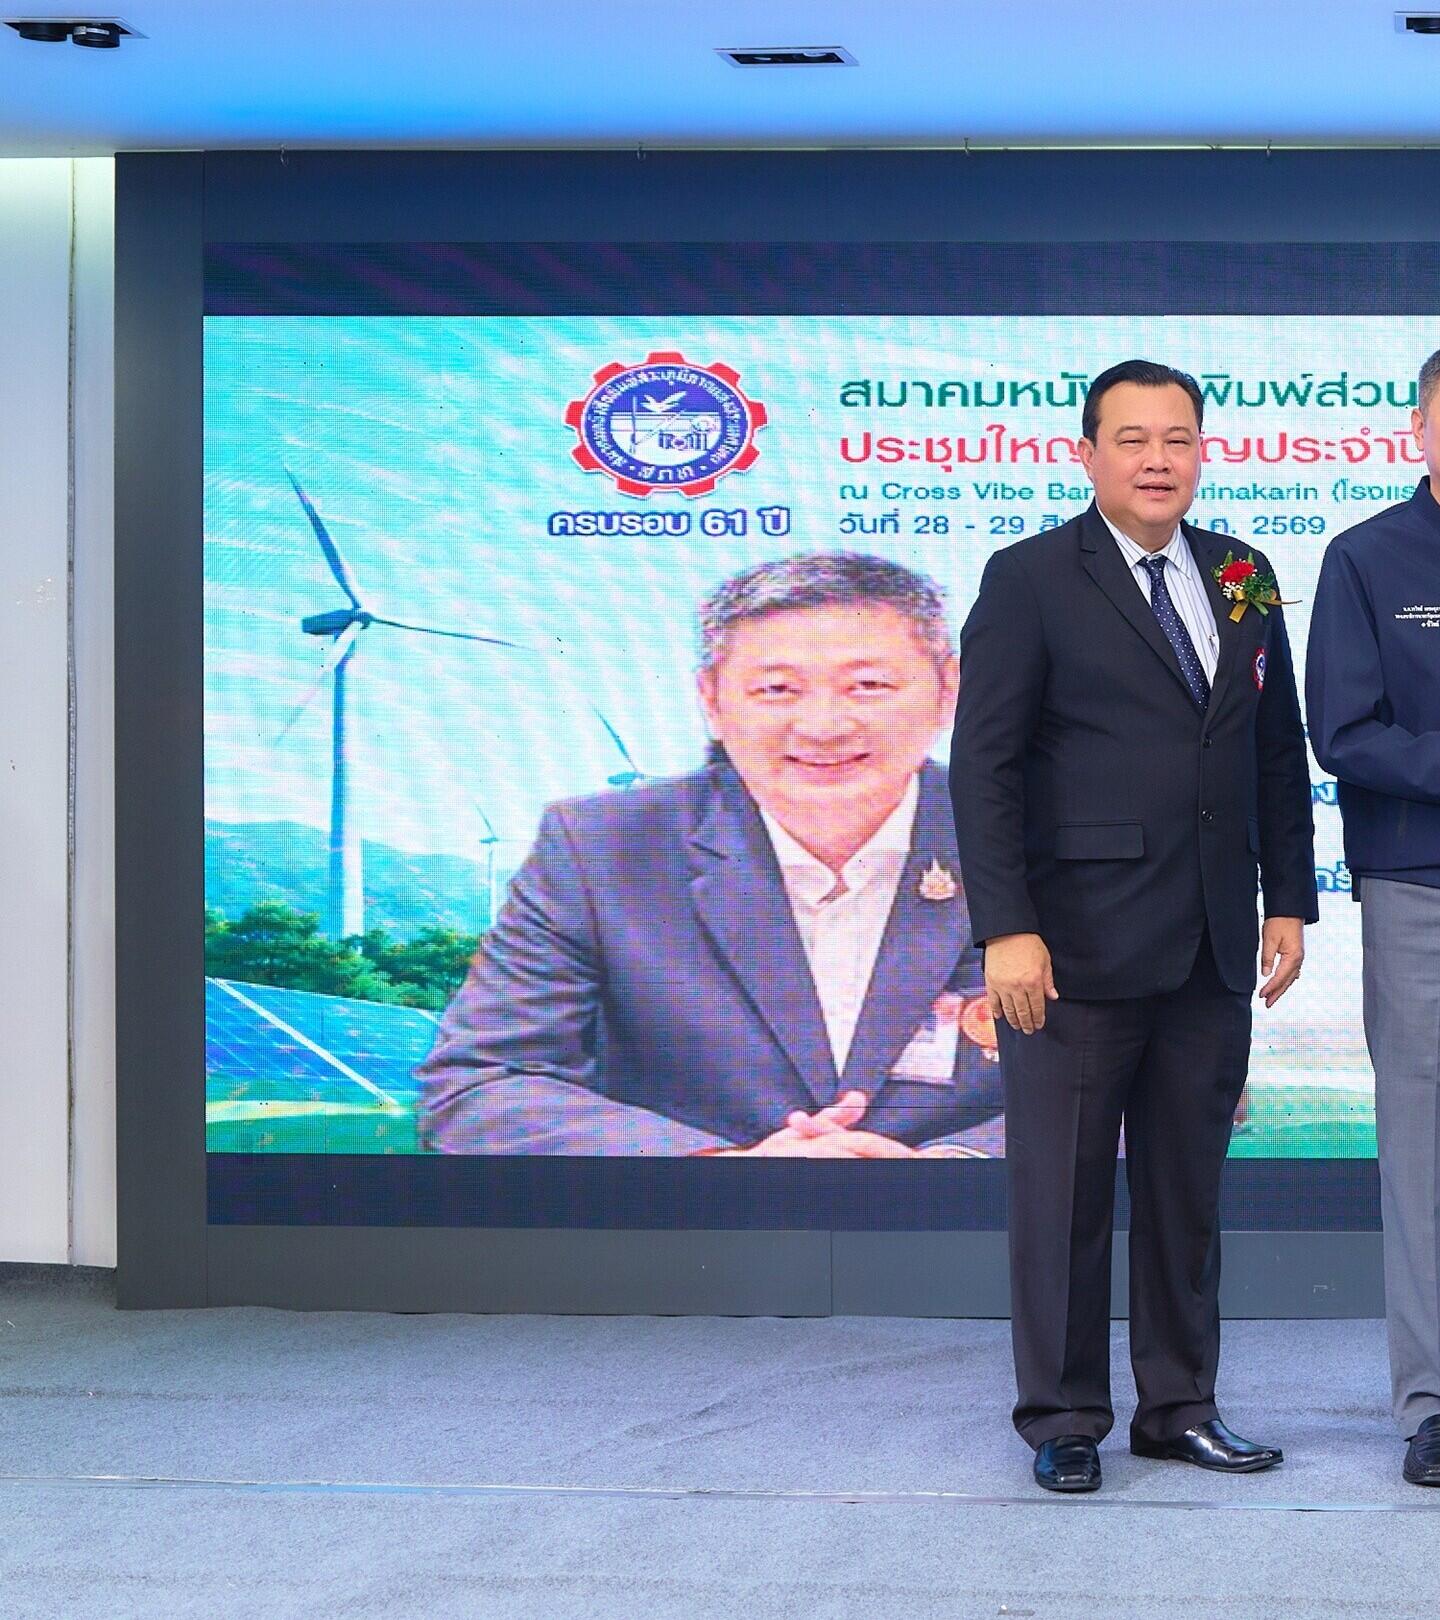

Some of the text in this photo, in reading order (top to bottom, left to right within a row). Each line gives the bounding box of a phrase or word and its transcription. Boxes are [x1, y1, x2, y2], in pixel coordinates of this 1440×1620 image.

[839, 483, 868, 500] ณ
[881, 482, 962, 500] Cross
[972, 481, 1035, 500] Vibe
[1196, 482, 1319, 501] rinakarin
[549, 506, 791, 536] ครบรอบ 61 ปี
[838, 508, 900, 535] วันที่
[913, 514, 950, 535] 28
[989, 514, 1025, 535] 29
[1252, 515, 1326, 535] 2569
